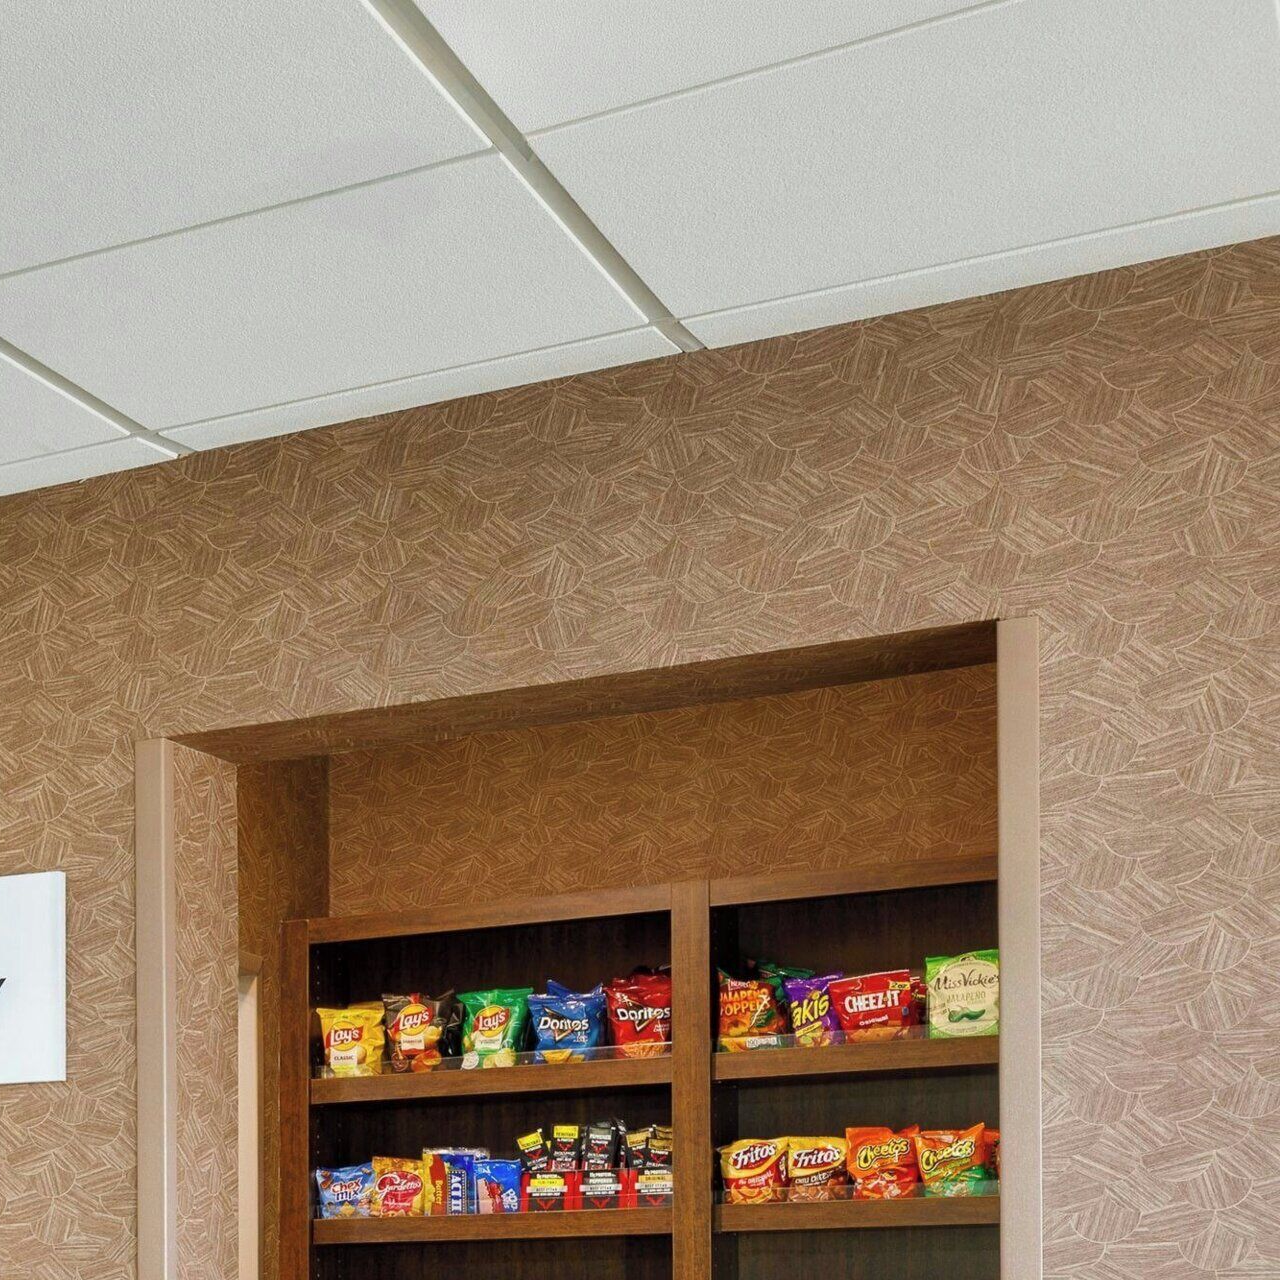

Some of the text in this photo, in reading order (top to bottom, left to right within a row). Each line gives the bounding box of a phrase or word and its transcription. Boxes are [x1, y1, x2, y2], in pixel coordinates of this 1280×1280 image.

[934, 976, 961, 991] Miss
[400, 1010, 429, 1031] Lay's
[616, 1007, 671, 1021] Doritos
[791, 992, 830, 1029] akis
[479, 1012, 506, 1031] Lay's
[540, 1017, 589, 1031] Doritos
[330, 1027, 360, 1046] Lay's
[731, 1143, 777, 1169] Fritos
[793, 1147, 841, 1168] Fritos
[857, 1138, 910, 1170] Cheetos
[920, 1139, 976, 1172] Cheetos
[330, 1176, 362, 1194] Chex
[451, 1174, 462, 1195] ACT
